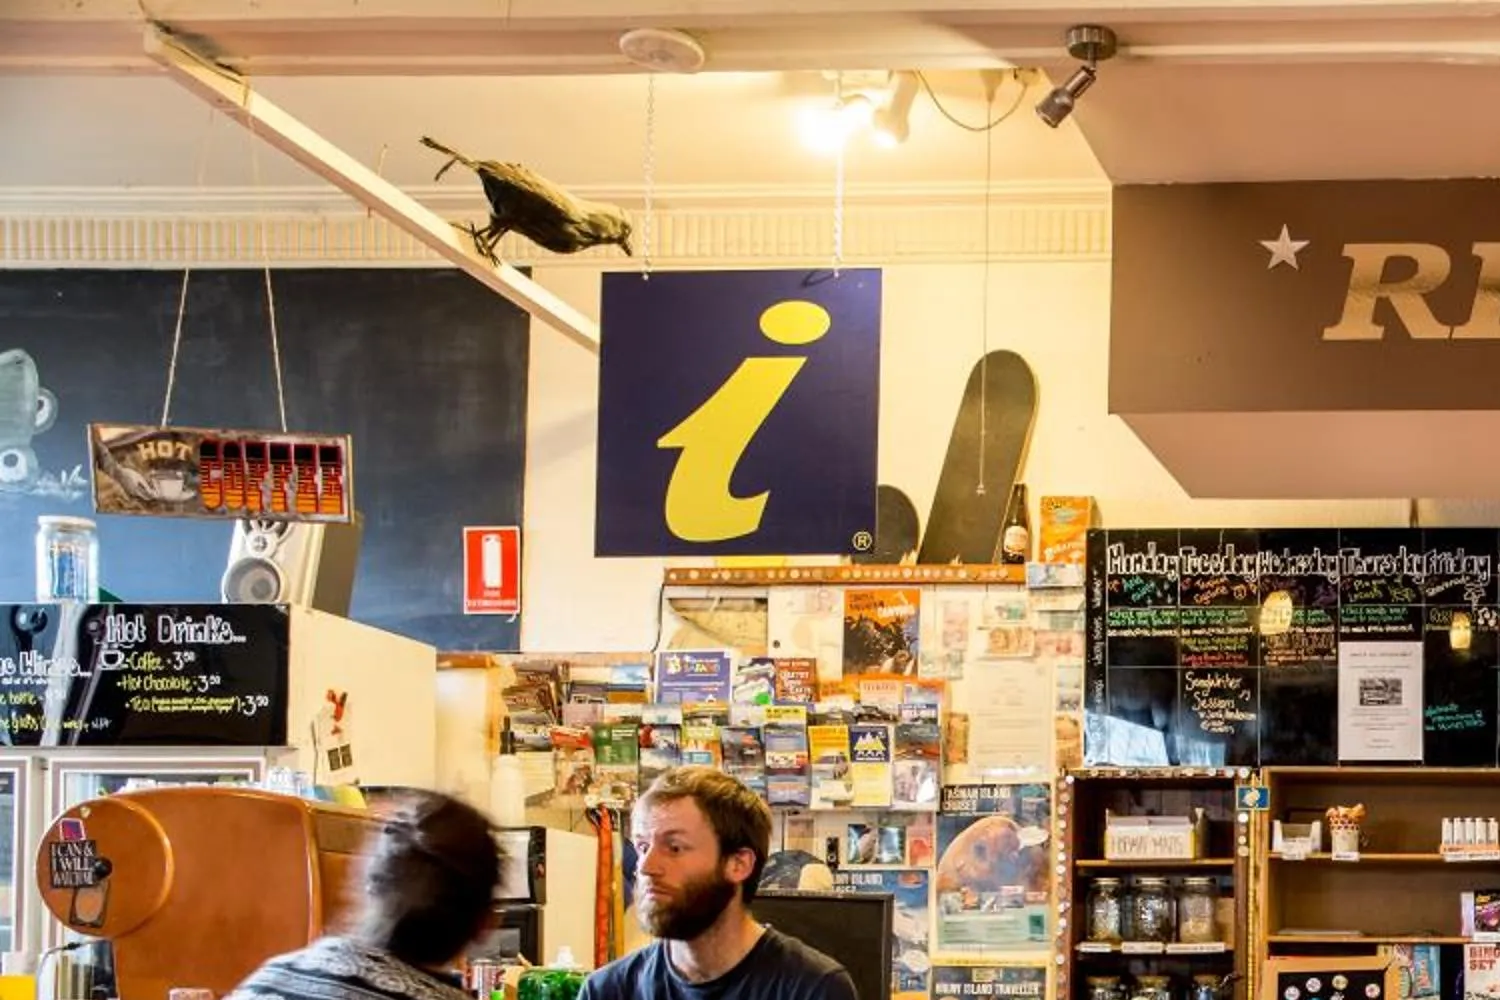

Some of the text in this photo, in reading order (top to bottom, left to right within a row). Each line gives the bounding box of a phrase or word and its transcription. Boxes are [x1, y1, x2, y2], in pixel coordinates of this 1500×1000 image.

[657, 300, 830, 542] i
[137, 440, 193, 461] HOT
[1106, 541, 1179, 580] Monday
[1180, 543, 1258, 583] Tuesday
[1340, 546, 1425, 584] Thursday
[1425, 548, 1490, 585] Friday
[107, 613, 146, 643] Hot
[1469, 959, 1497, 971] SET
